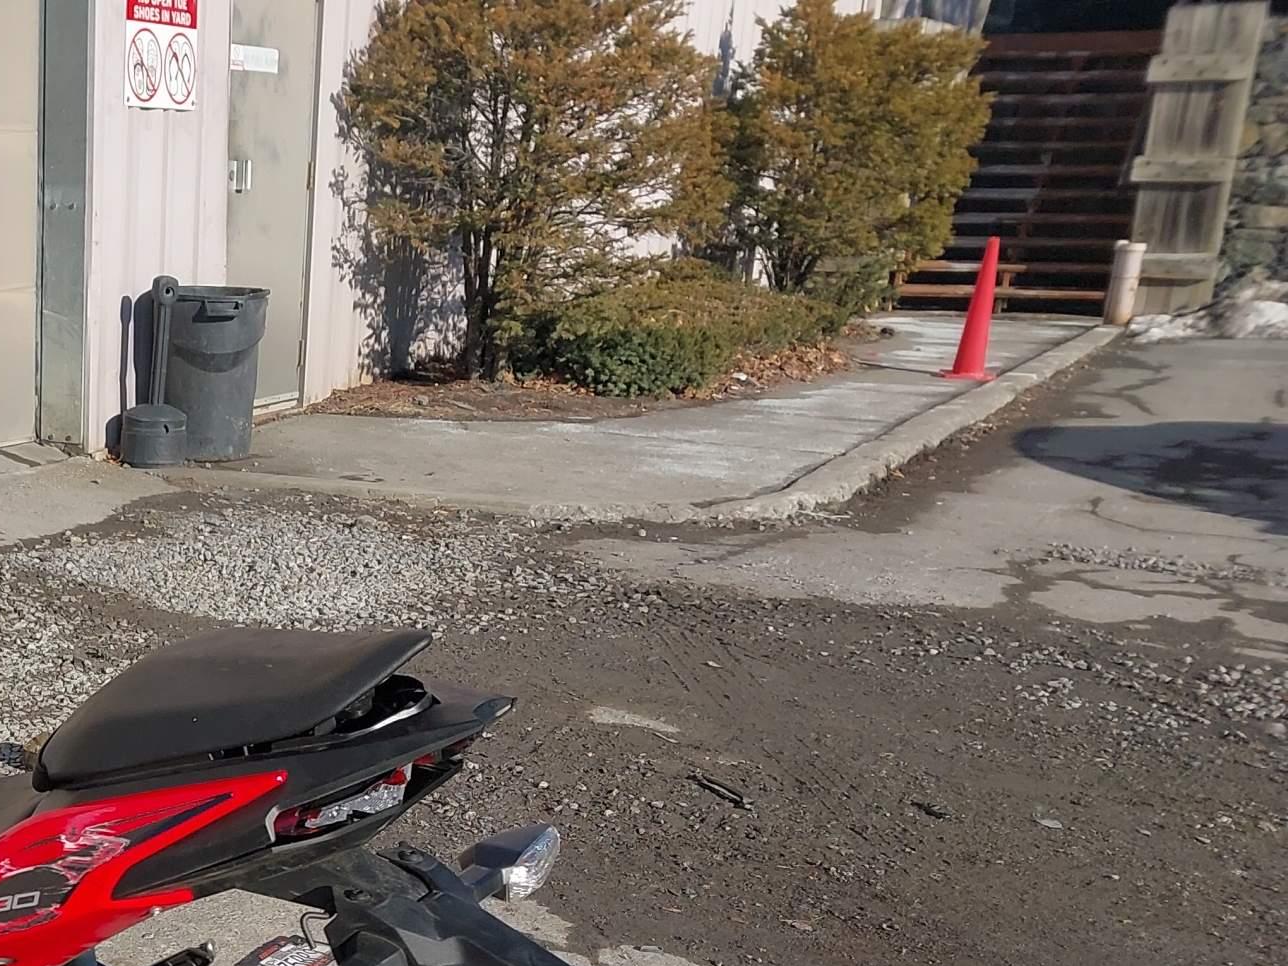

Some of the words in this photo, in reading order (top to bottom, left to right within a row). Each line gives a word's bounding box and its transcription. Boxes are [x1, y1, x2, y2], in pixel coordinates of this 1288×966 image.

[133, 5, 160, 21] SHOES
[161, 9, 171, 23] IN
[171, 11, 192, 26] YARD
